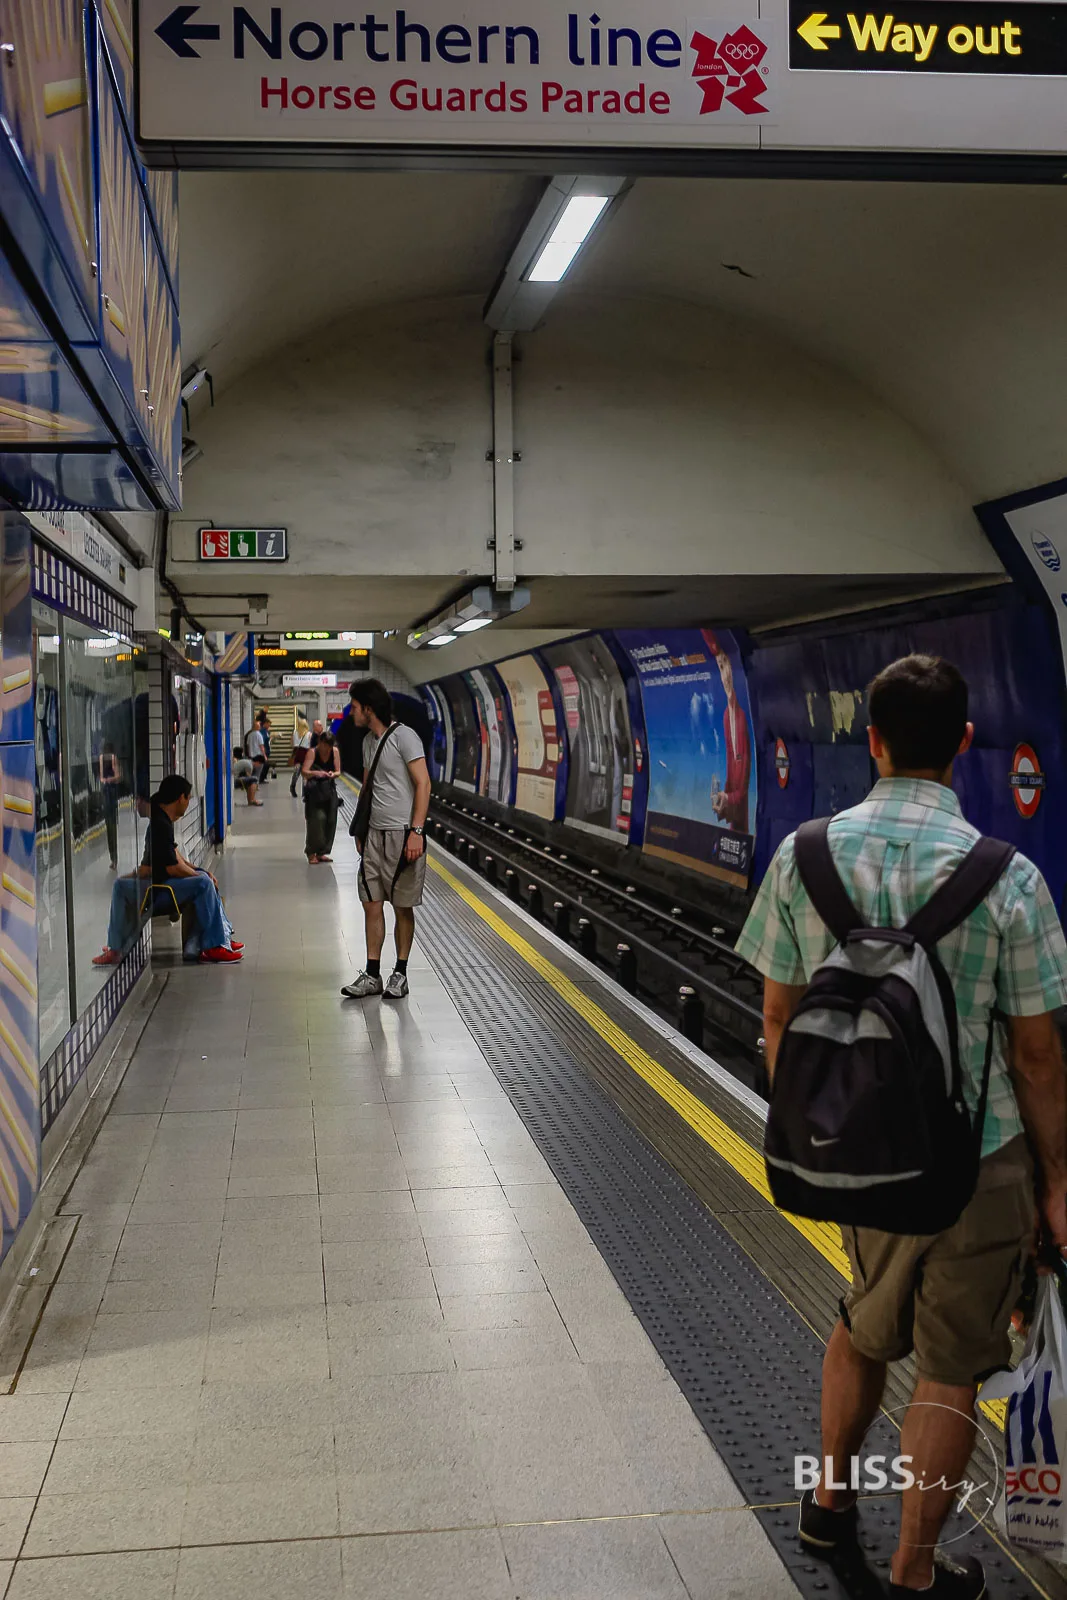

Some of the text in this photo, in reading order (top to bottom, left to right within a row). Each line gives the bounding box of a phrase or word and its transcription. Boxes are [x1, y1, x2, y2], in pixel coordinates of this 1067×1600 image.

[232, 6, 687, 69] Northern line
[846, 13, 1023, 62] Way out
[261, 77, 671, 115] Horse Guards Parade
